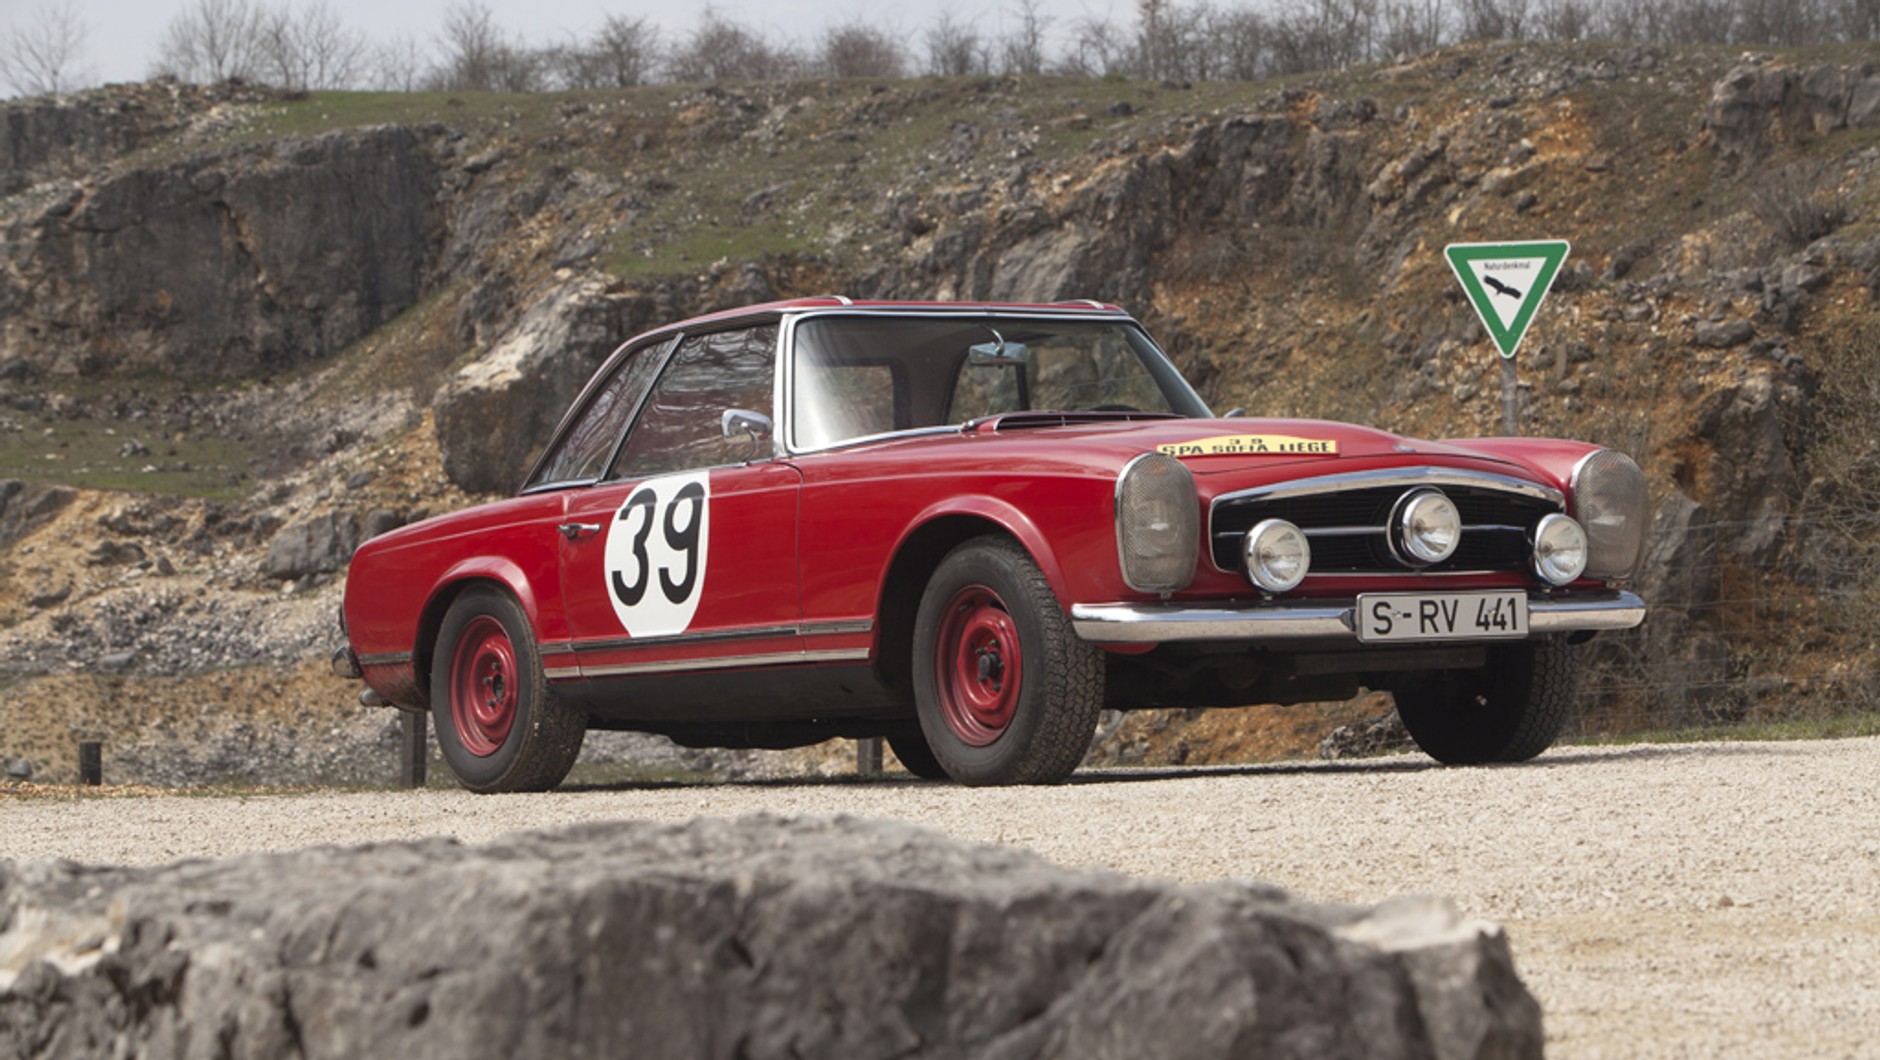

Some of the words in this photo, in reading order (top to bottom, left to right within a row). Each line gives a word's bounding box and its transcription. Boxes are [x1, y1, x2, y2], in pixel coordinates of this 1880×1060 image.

[1483, 261, 1530, 270] Naturdenkmal
[1162, 445, 1204, 456] SPA
[1212, 443, 1269, 453] SOFIA
[1279, 442, 1330, 452] LIEGE
[612, 481, 705, 607] 39
[1475, 597, 1517, 631] 441
